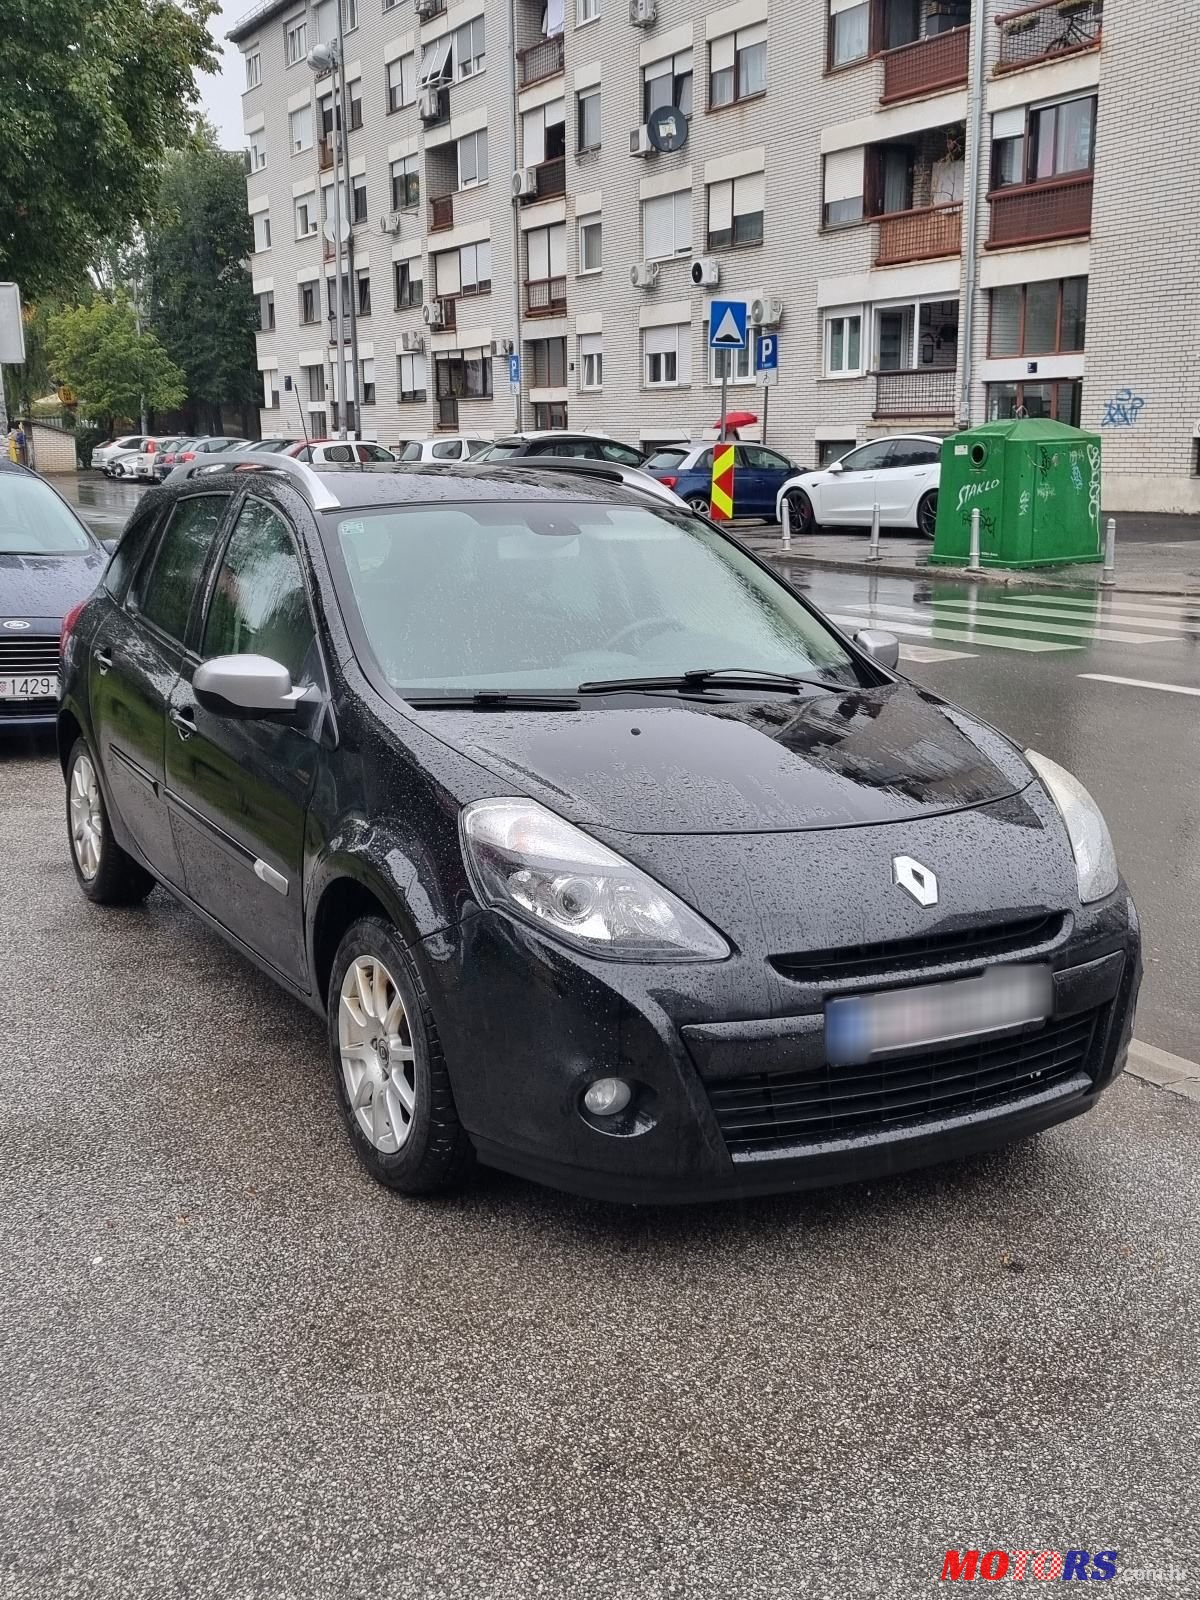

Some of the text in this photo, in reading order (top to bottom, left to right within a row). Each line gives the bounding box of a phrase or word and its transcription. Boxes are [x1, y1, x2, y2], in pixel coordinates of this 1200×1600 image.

[762, 338, 773, 363] P
[956, 478, 1000, 511] STAKLO
[11, 678, 57, 695] 1429-
